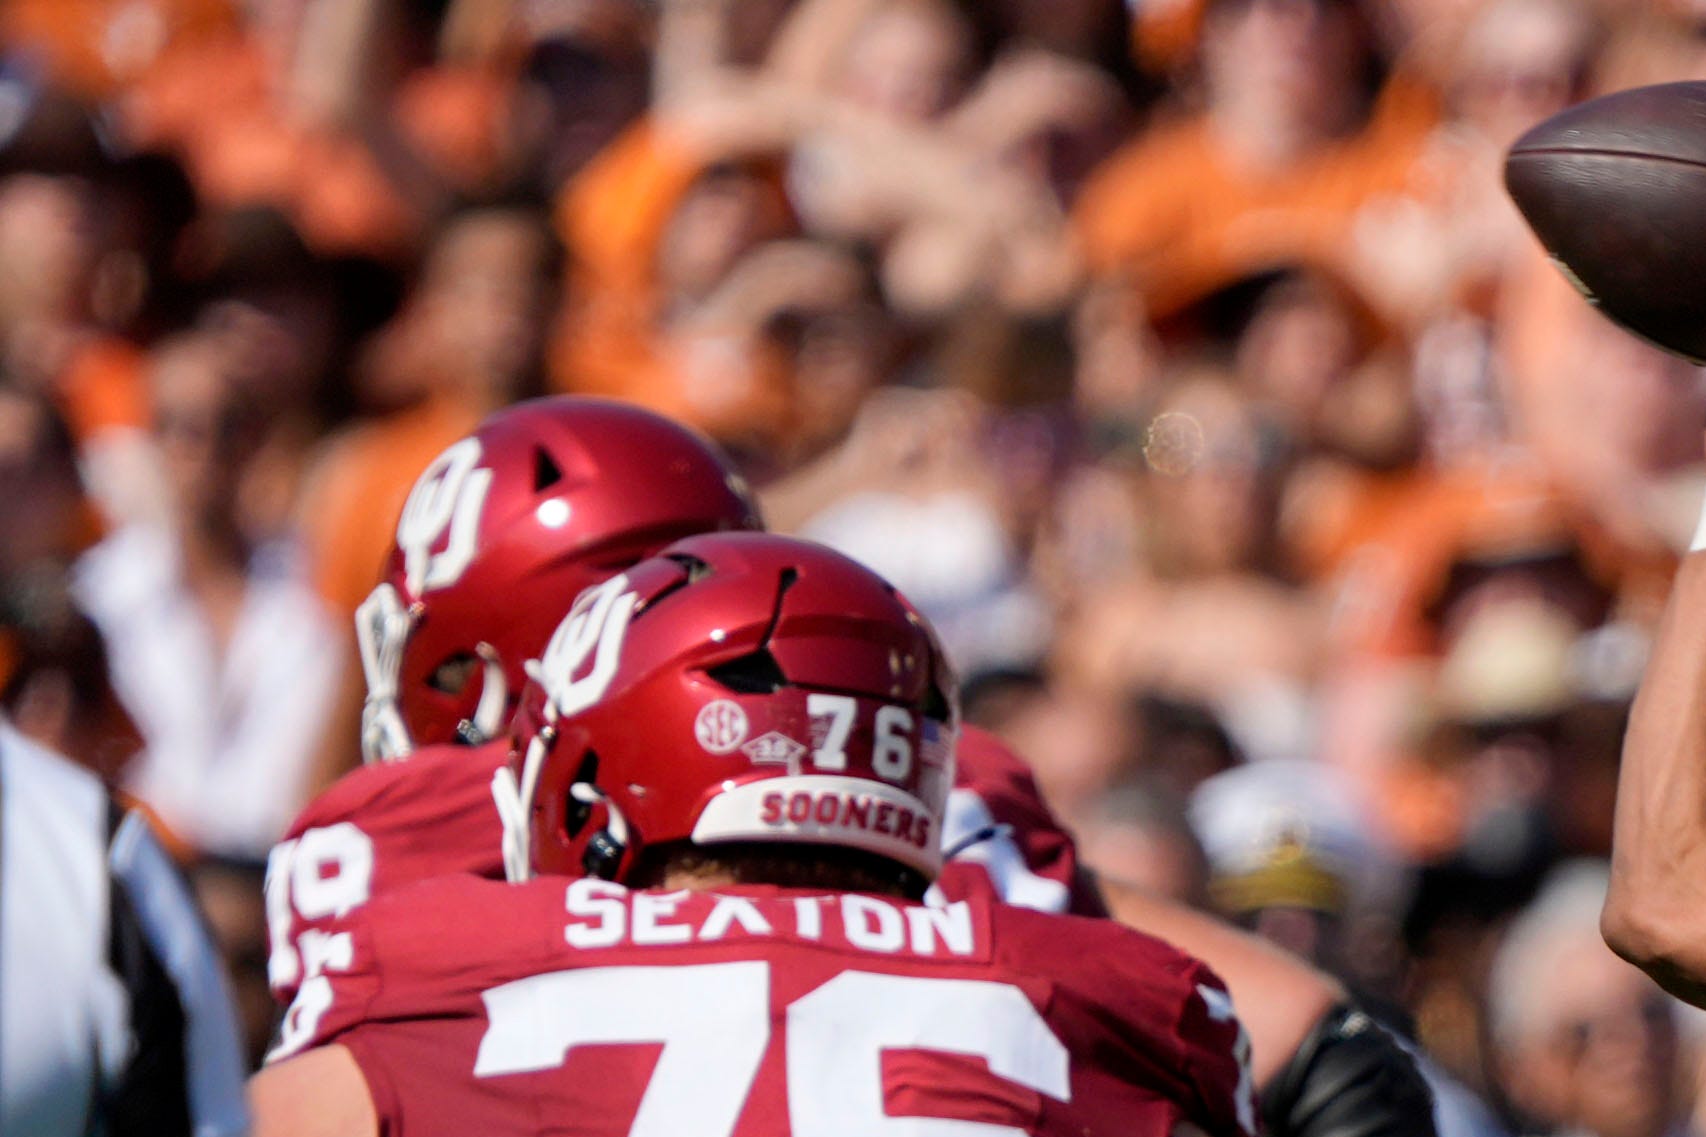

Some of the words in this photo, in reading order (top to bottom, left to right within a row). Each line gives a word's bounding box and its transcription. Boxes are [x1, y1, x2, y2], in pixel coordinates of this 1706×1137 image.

[806, 693, 912, 781] 76
[760, 791, 930, 848] SOONERS
[565, 878, 973, 955] SEXTON
